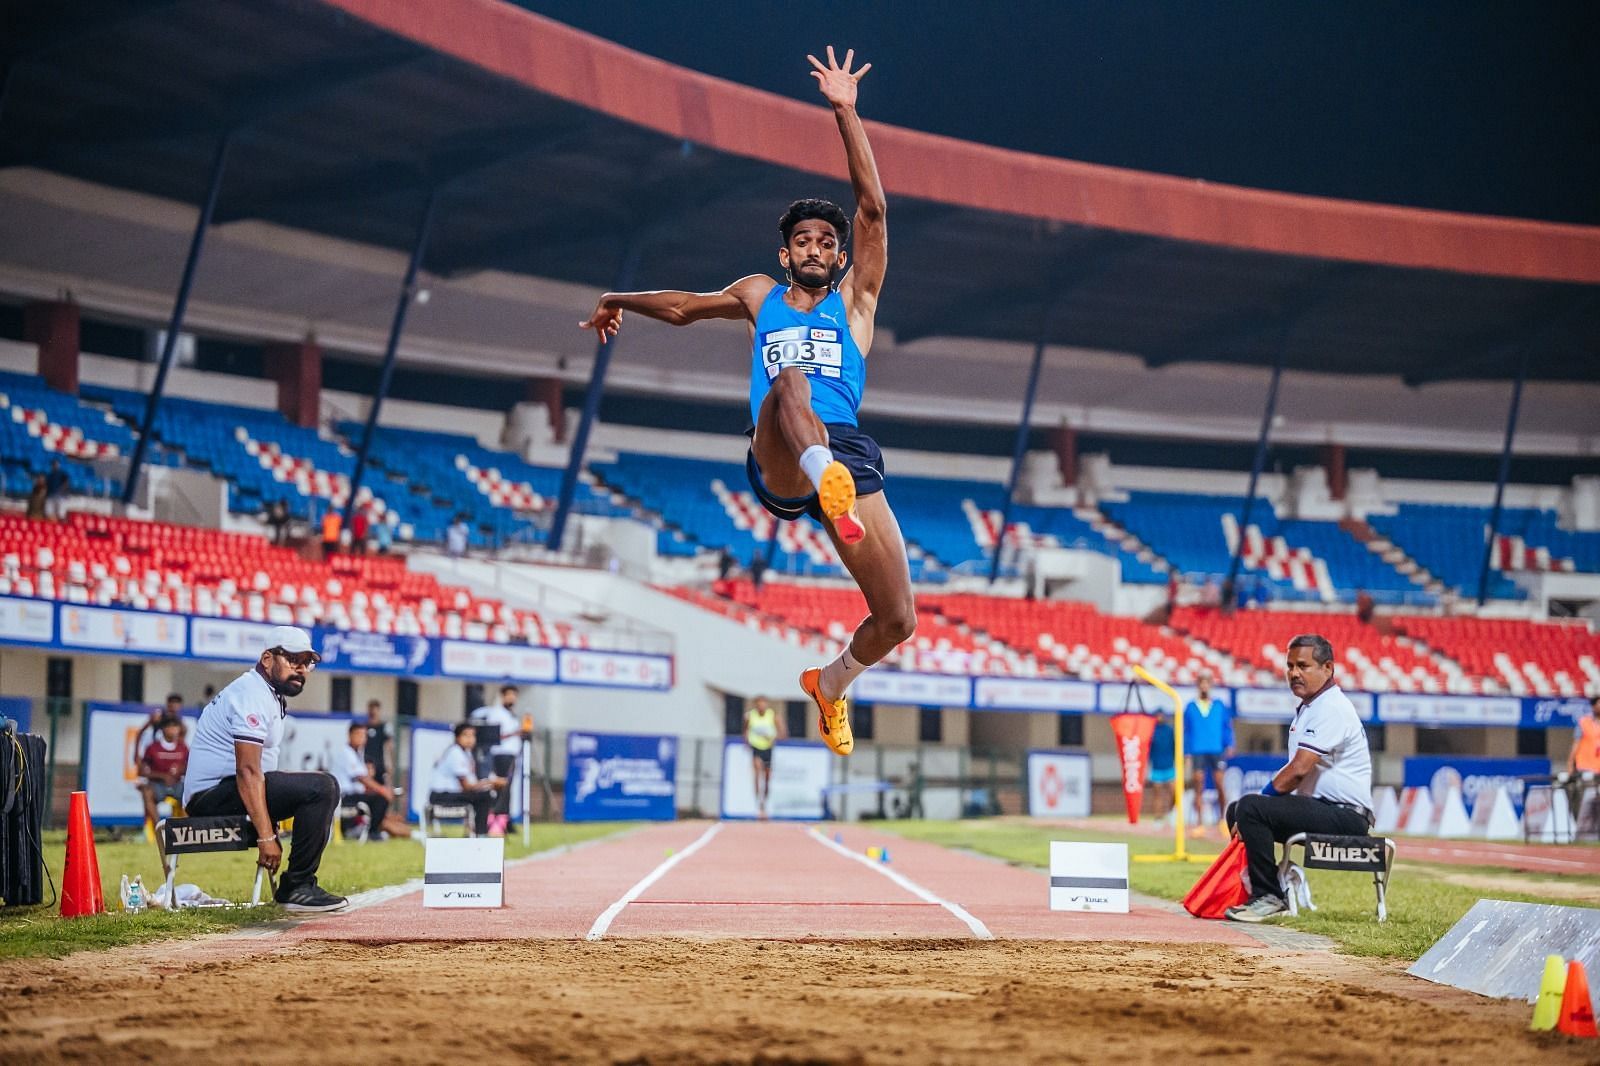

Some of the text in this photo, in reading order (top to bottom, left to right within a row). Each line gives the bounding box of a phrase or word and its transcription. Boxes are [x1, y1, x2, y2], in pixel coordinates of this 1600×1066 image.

[767, 341, 816, 363] 603
[172, 826, 242, 847] Vinex
[1310, 841, 1380, 863] Vinex
